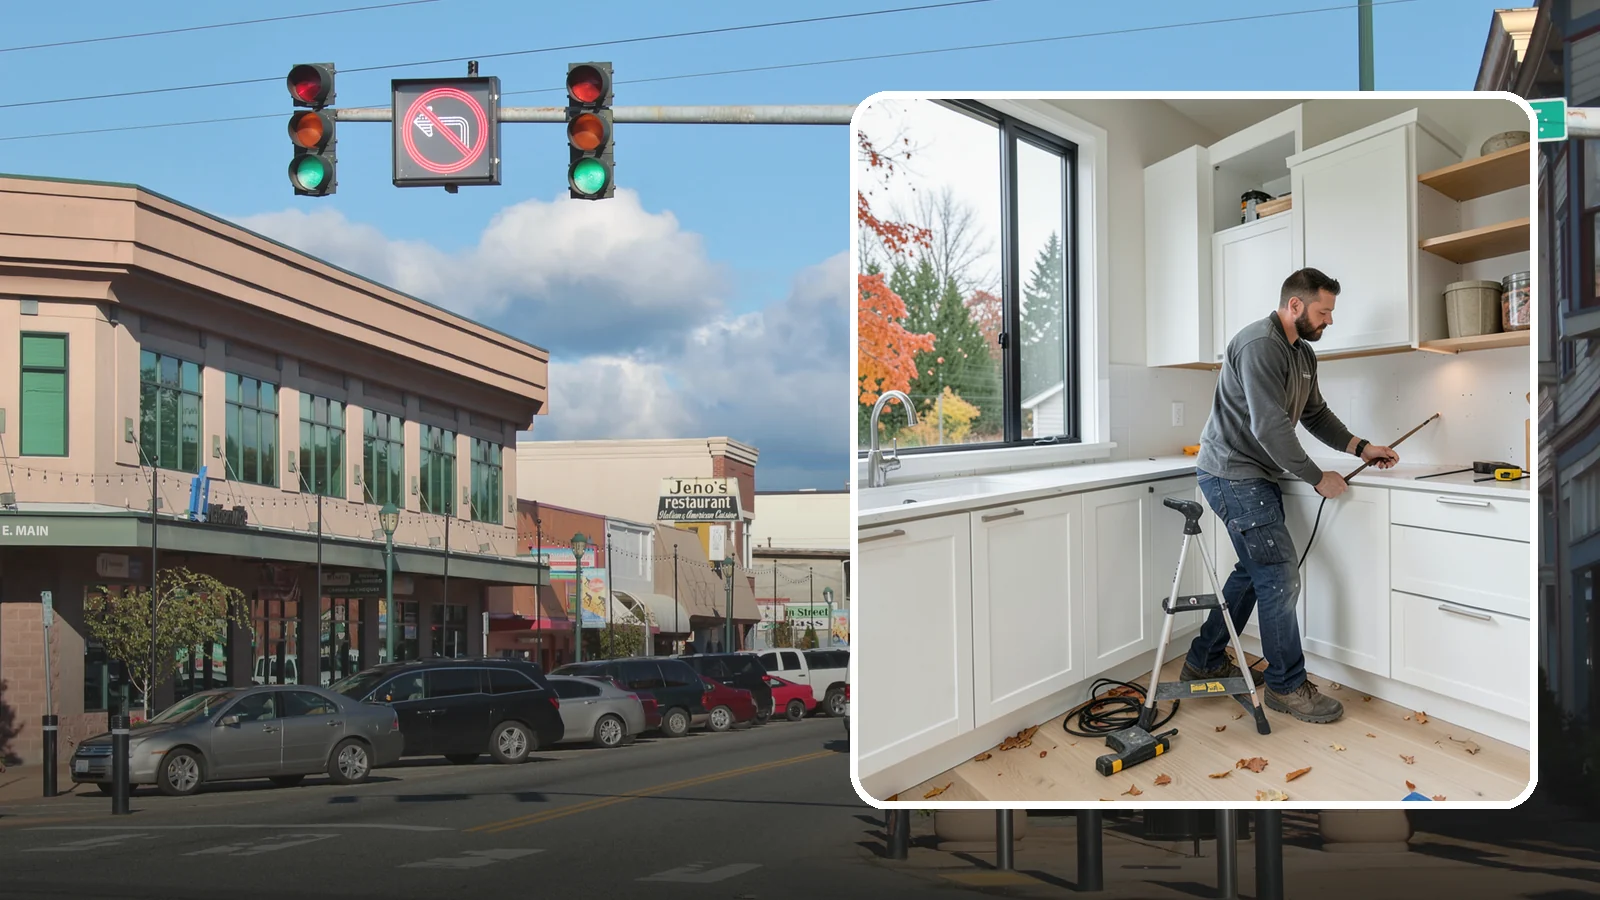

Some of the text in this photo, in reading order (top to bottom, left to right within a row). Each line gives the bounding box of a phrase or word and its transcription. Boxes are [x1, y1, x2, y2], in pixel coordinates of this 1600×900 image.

[669, 479, 727, 495] Jeno's
[665, 496, 731, 509] restaurant
[658, 510, 681, 519] Italian
[685, 509, 714, 519] American
[714, 509, 738, 519] Cuisine
[2, 524, 49, 536] E. MAIN
[797, 608, 829, 617] Street
